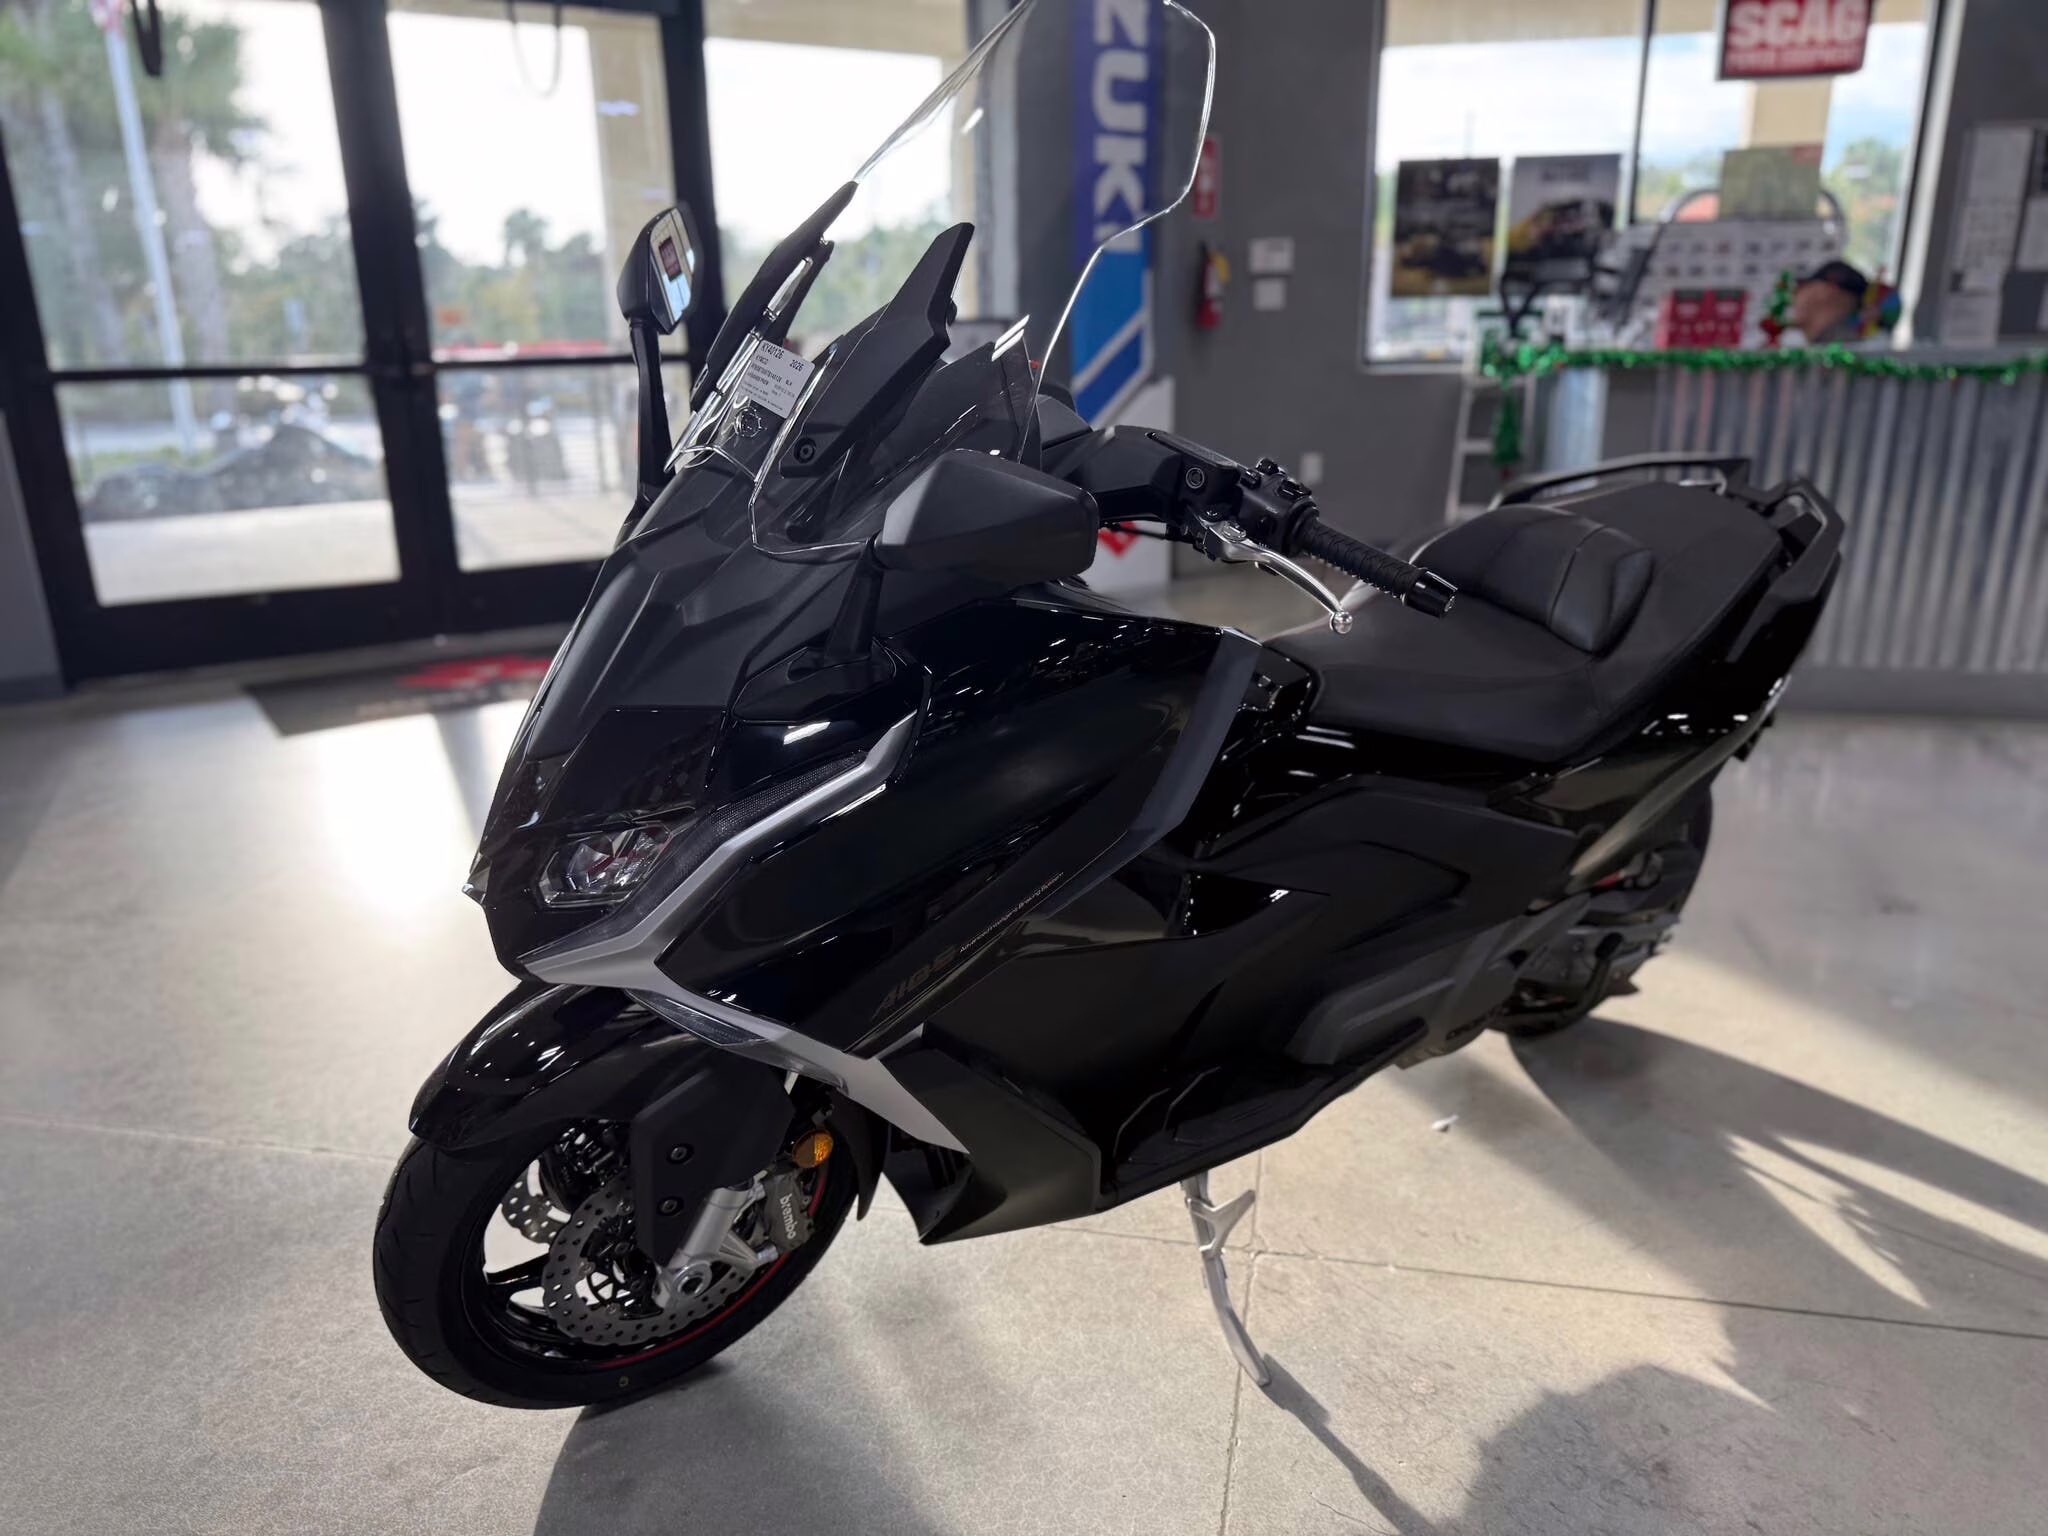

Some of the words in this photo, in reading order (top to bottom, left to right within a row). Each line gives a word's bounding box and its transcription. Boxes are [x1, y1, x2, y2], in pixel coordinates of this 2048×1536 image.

[1729, 0, 1865, 47] SCAG
[789, 359, 804, 371] 2026
[779, 1192, 799, 1240] brembo
